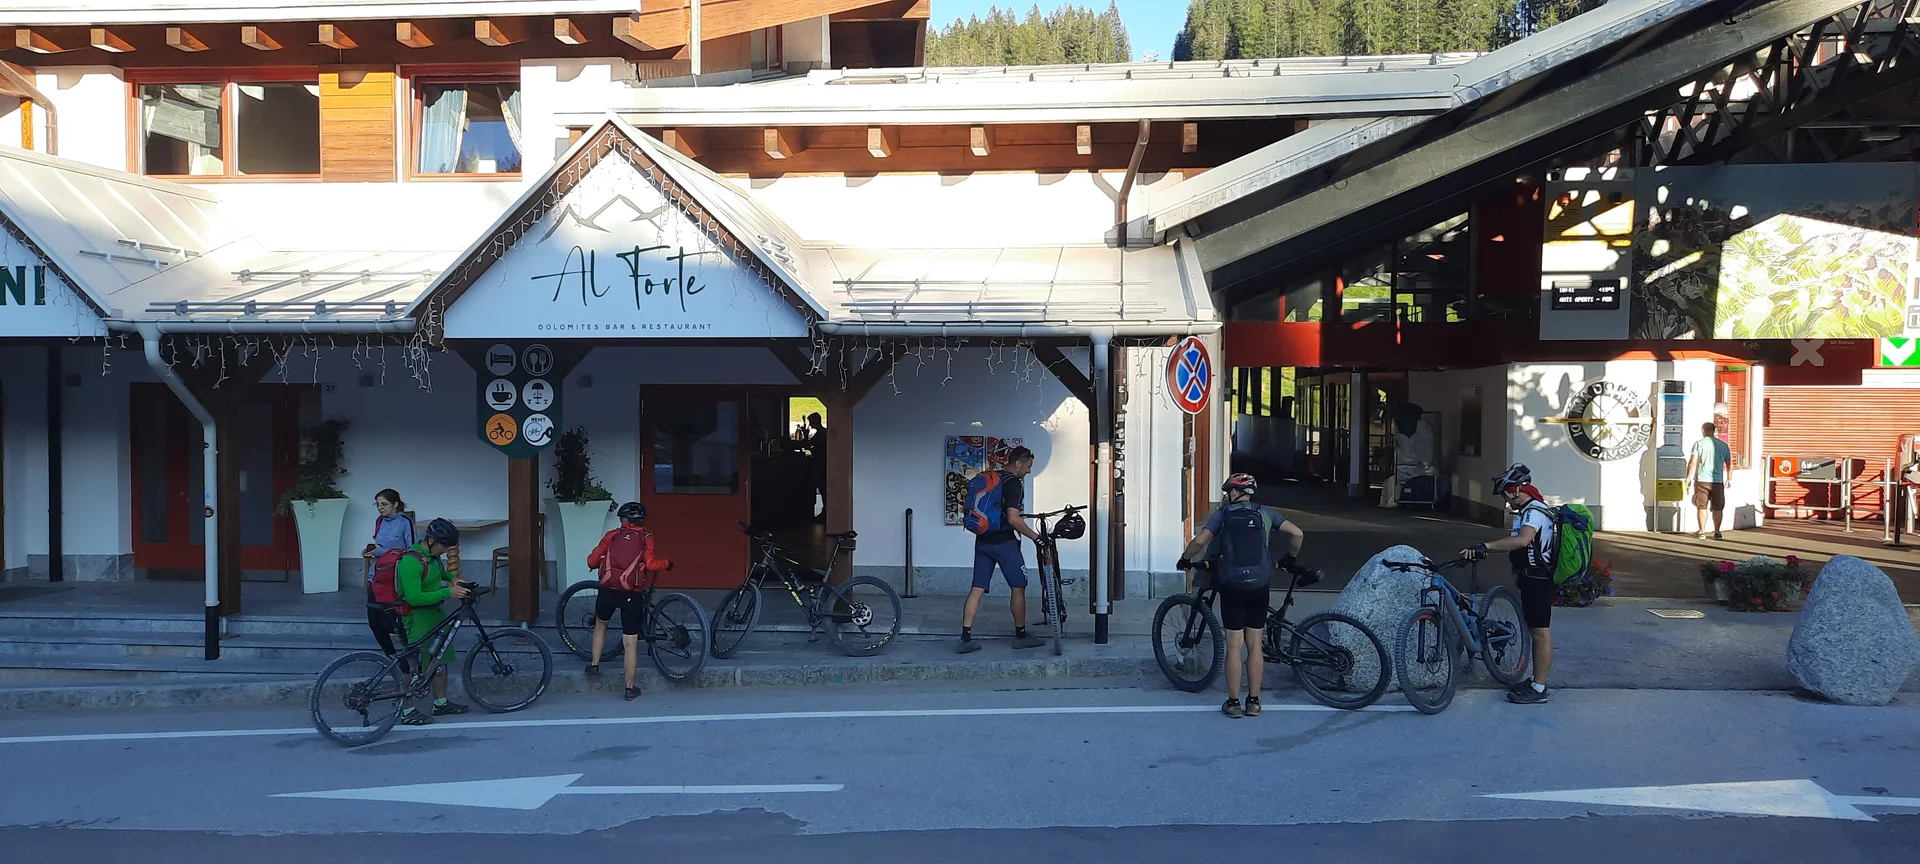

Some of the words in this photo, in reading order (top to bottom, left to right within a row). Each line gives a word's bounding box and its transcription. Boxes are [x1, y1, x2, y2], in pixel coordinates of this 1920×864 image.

[530, 245, 611, 307] Al
[615, 244, 718, 313] Forte
[537, 323, 600, 332] DOLOMITES
[605, 323, 626, 331] BAR
[630, 323, 636, 331] &
[641, 322, 713, 331] RESTAURANT
[324, 384, 336, 392] 27
